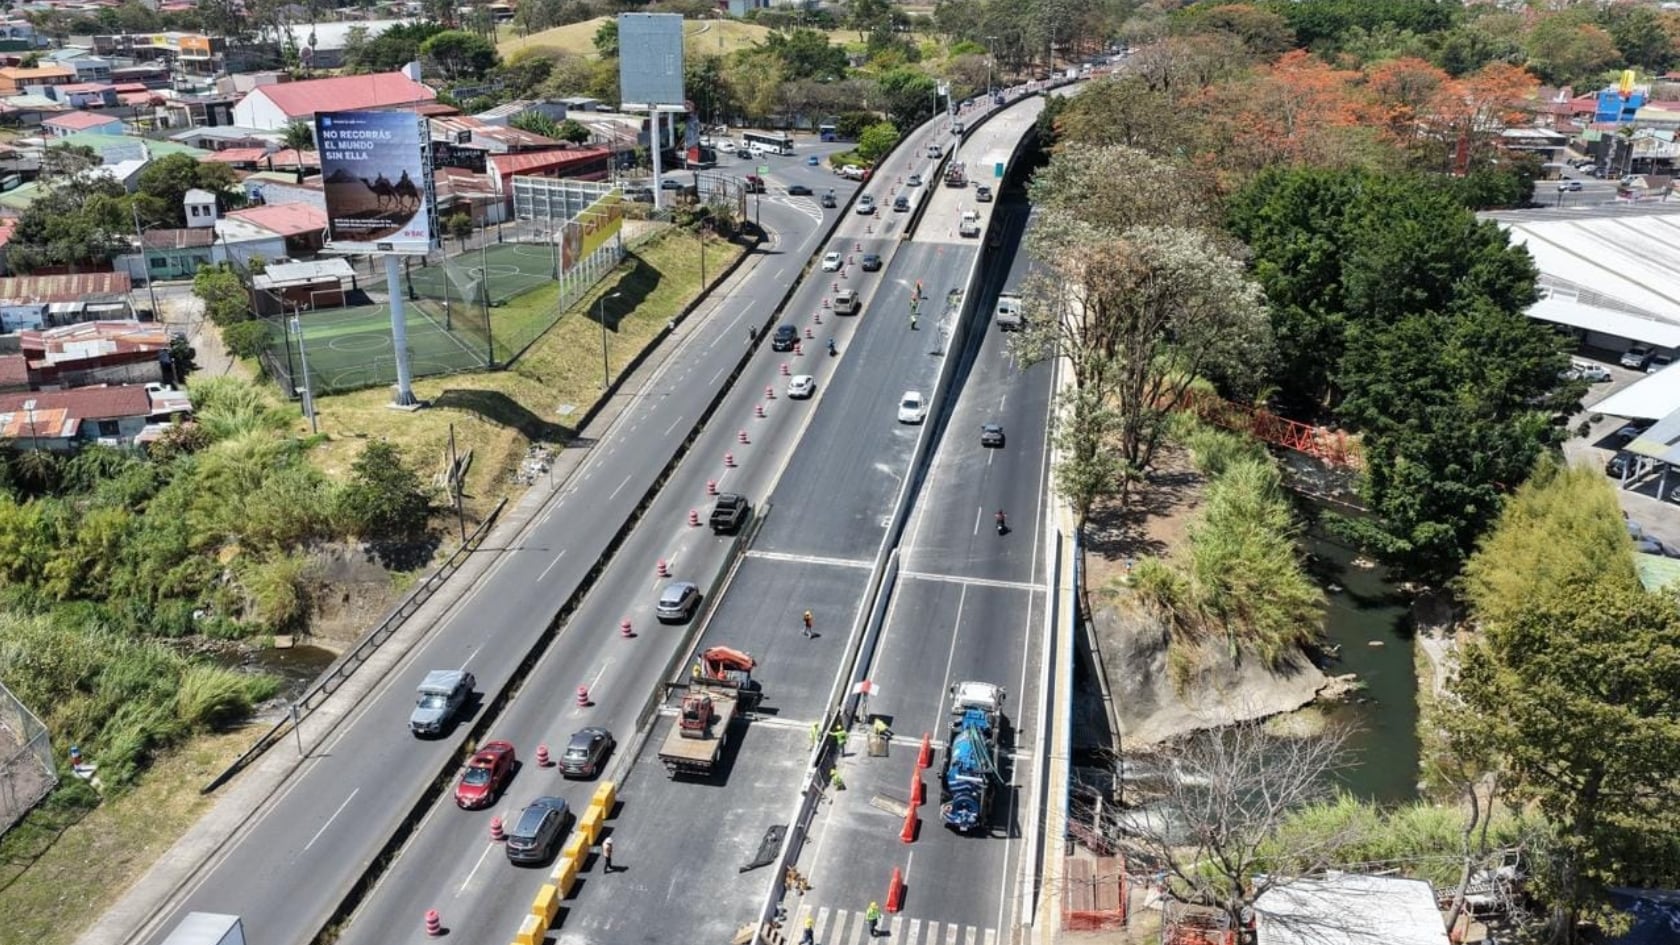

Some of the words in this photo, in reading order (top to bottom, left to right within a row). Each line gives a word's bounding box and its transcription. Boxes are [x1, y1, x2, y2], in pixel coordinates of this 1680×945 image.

[323, 130, 337, 139] NO
[340, 129, 392, 139] RECORRÁS
[325, 141, 336, 149] EL
[338, 141, 374, 149] MUNDO
[326, 152, 343, 160] SIN
[345, 152, 368, 160] ELLA
